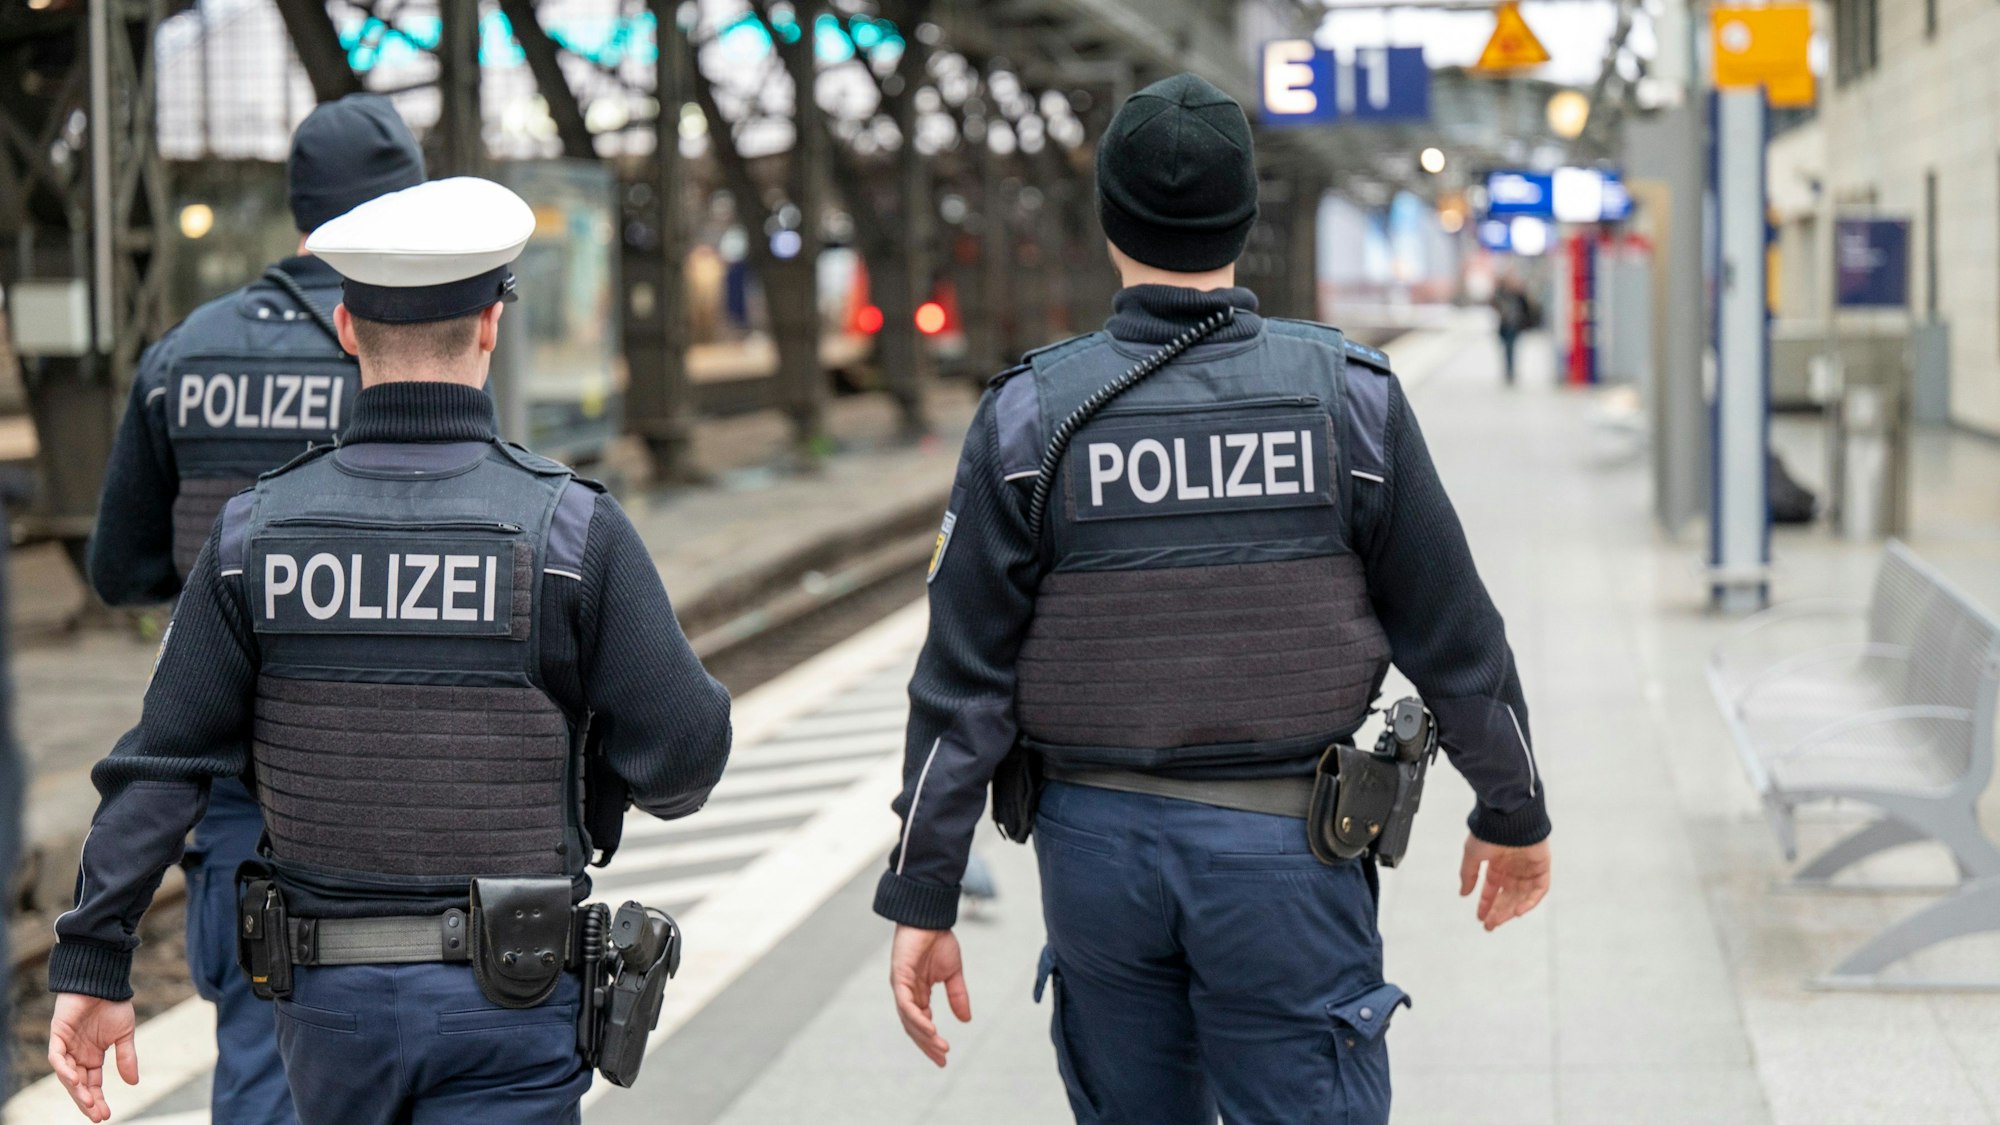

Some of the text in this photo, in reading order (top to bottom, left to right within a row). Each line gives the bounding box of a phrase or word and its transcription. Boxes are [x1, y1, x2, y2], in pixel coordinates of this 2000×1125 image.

[1264, 39, 1316, 114] E
[178, 373, 344, 430] POLIZEI
[1087, 429, 1316, 508] POLIZEI
[263, 552, 498, 622] POLIZEI
